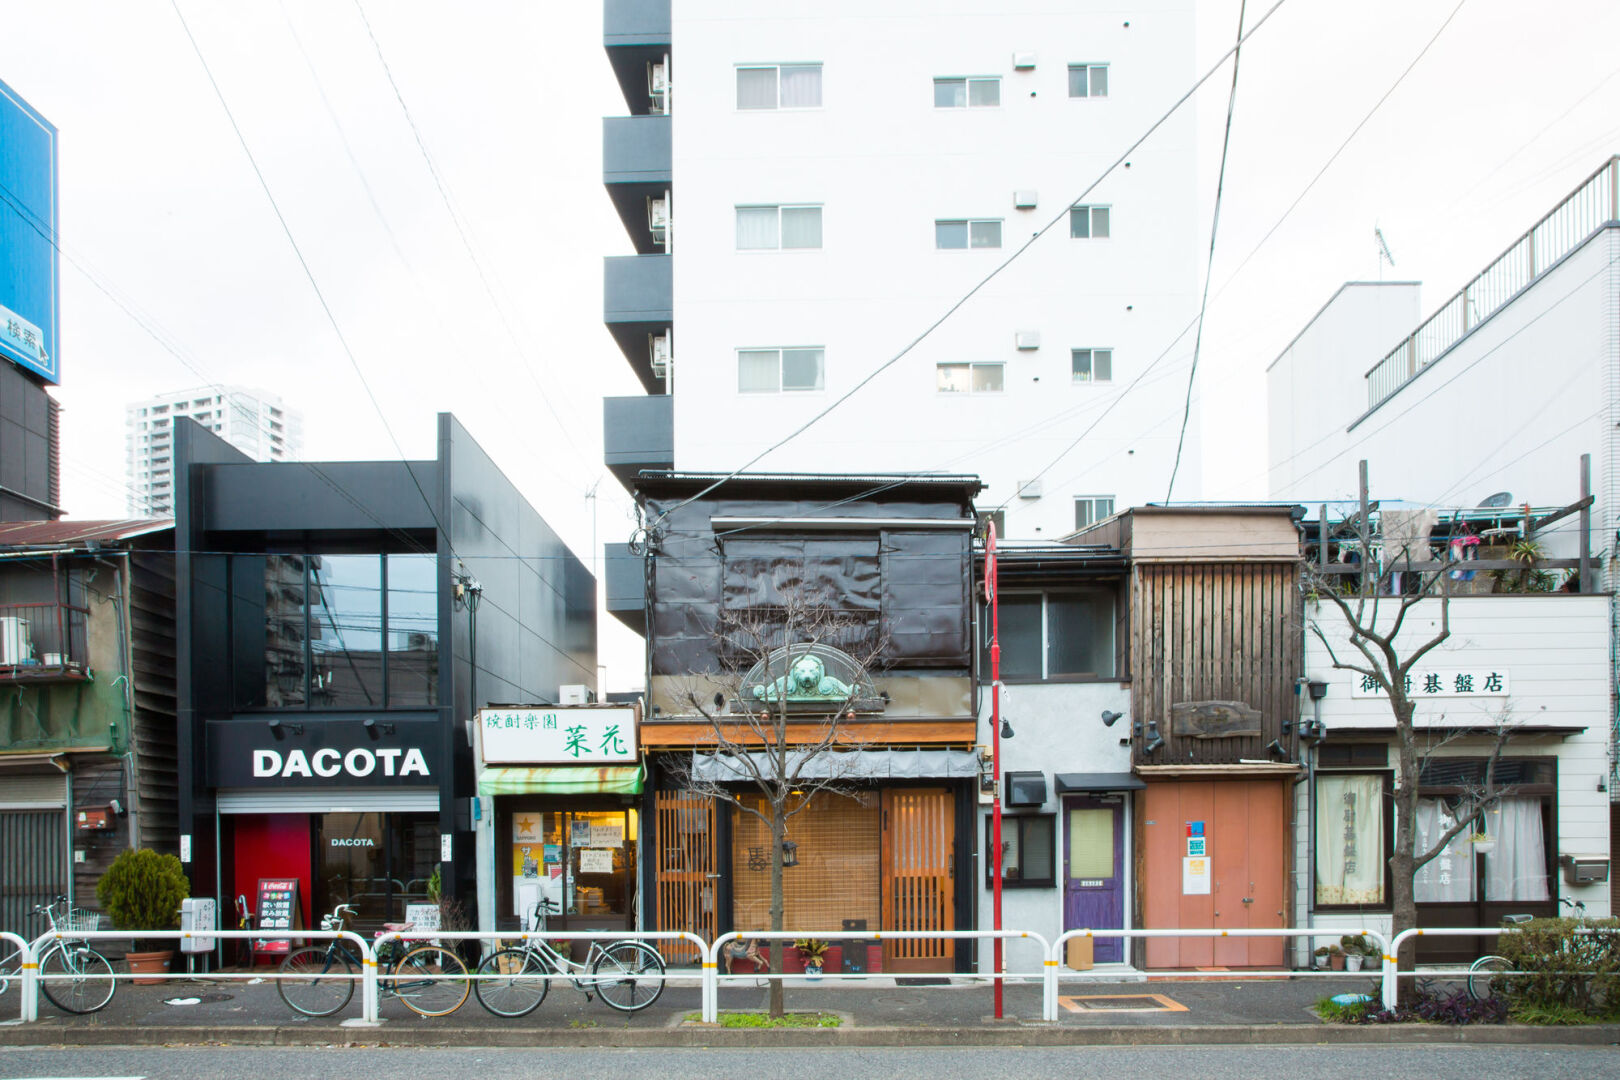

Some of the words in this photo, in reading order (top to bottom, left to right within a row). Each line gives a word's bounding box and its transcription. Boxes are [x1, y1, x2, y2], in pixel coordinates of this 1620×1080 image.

[7, 318, 37, 350] 検索
[563, 724, 629, 759] 菜花
[252, 748, 430, 778] DACOTA
[331, 838, 374, 847] DACOTA
